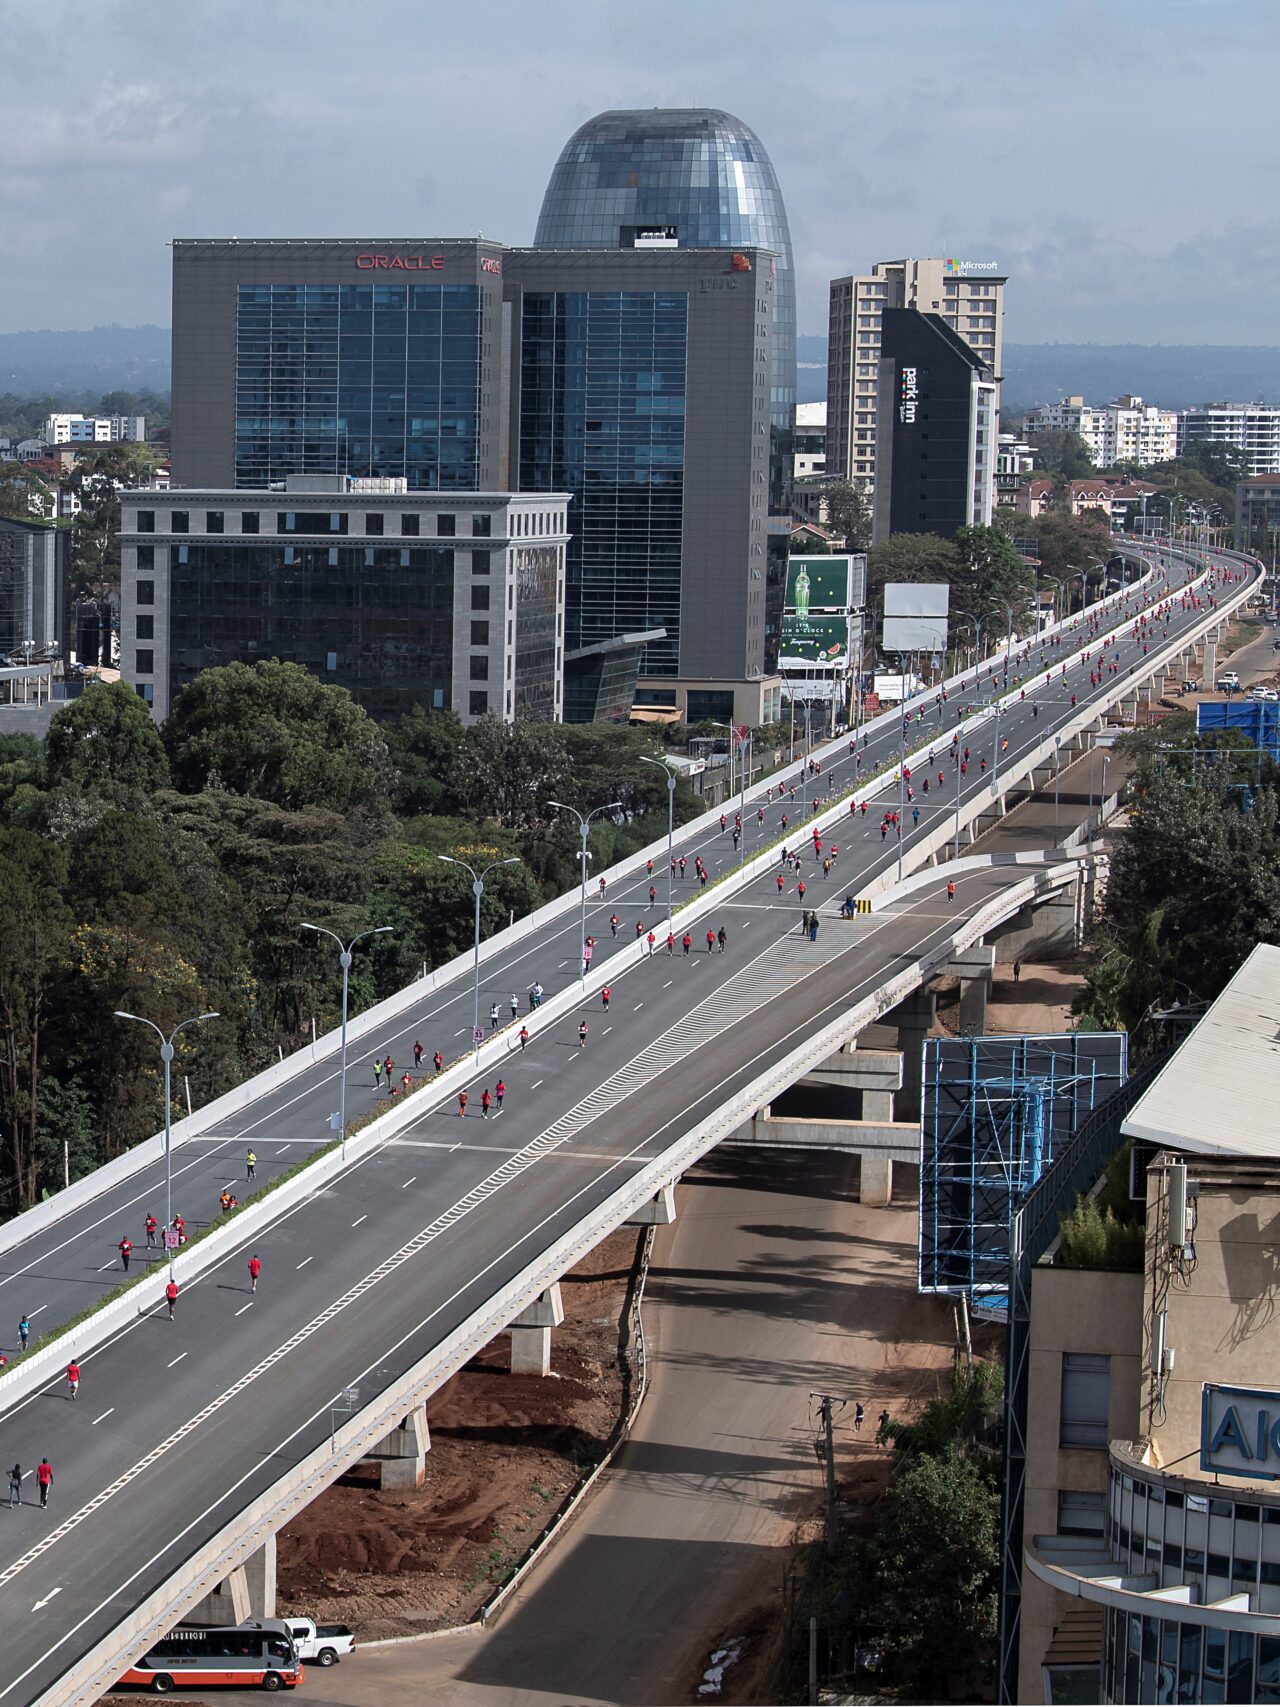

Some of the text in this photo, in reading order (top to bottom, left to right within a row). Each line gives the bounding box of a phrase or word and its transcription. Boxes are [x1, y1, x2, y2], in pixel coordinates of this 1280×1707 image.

[356, 255, 446, 270] ORACLE
[960, 261, 998, 270] Microsoft
[903, 367, 919, 423] park inn
[167, 1237, 177, 1245] 12
